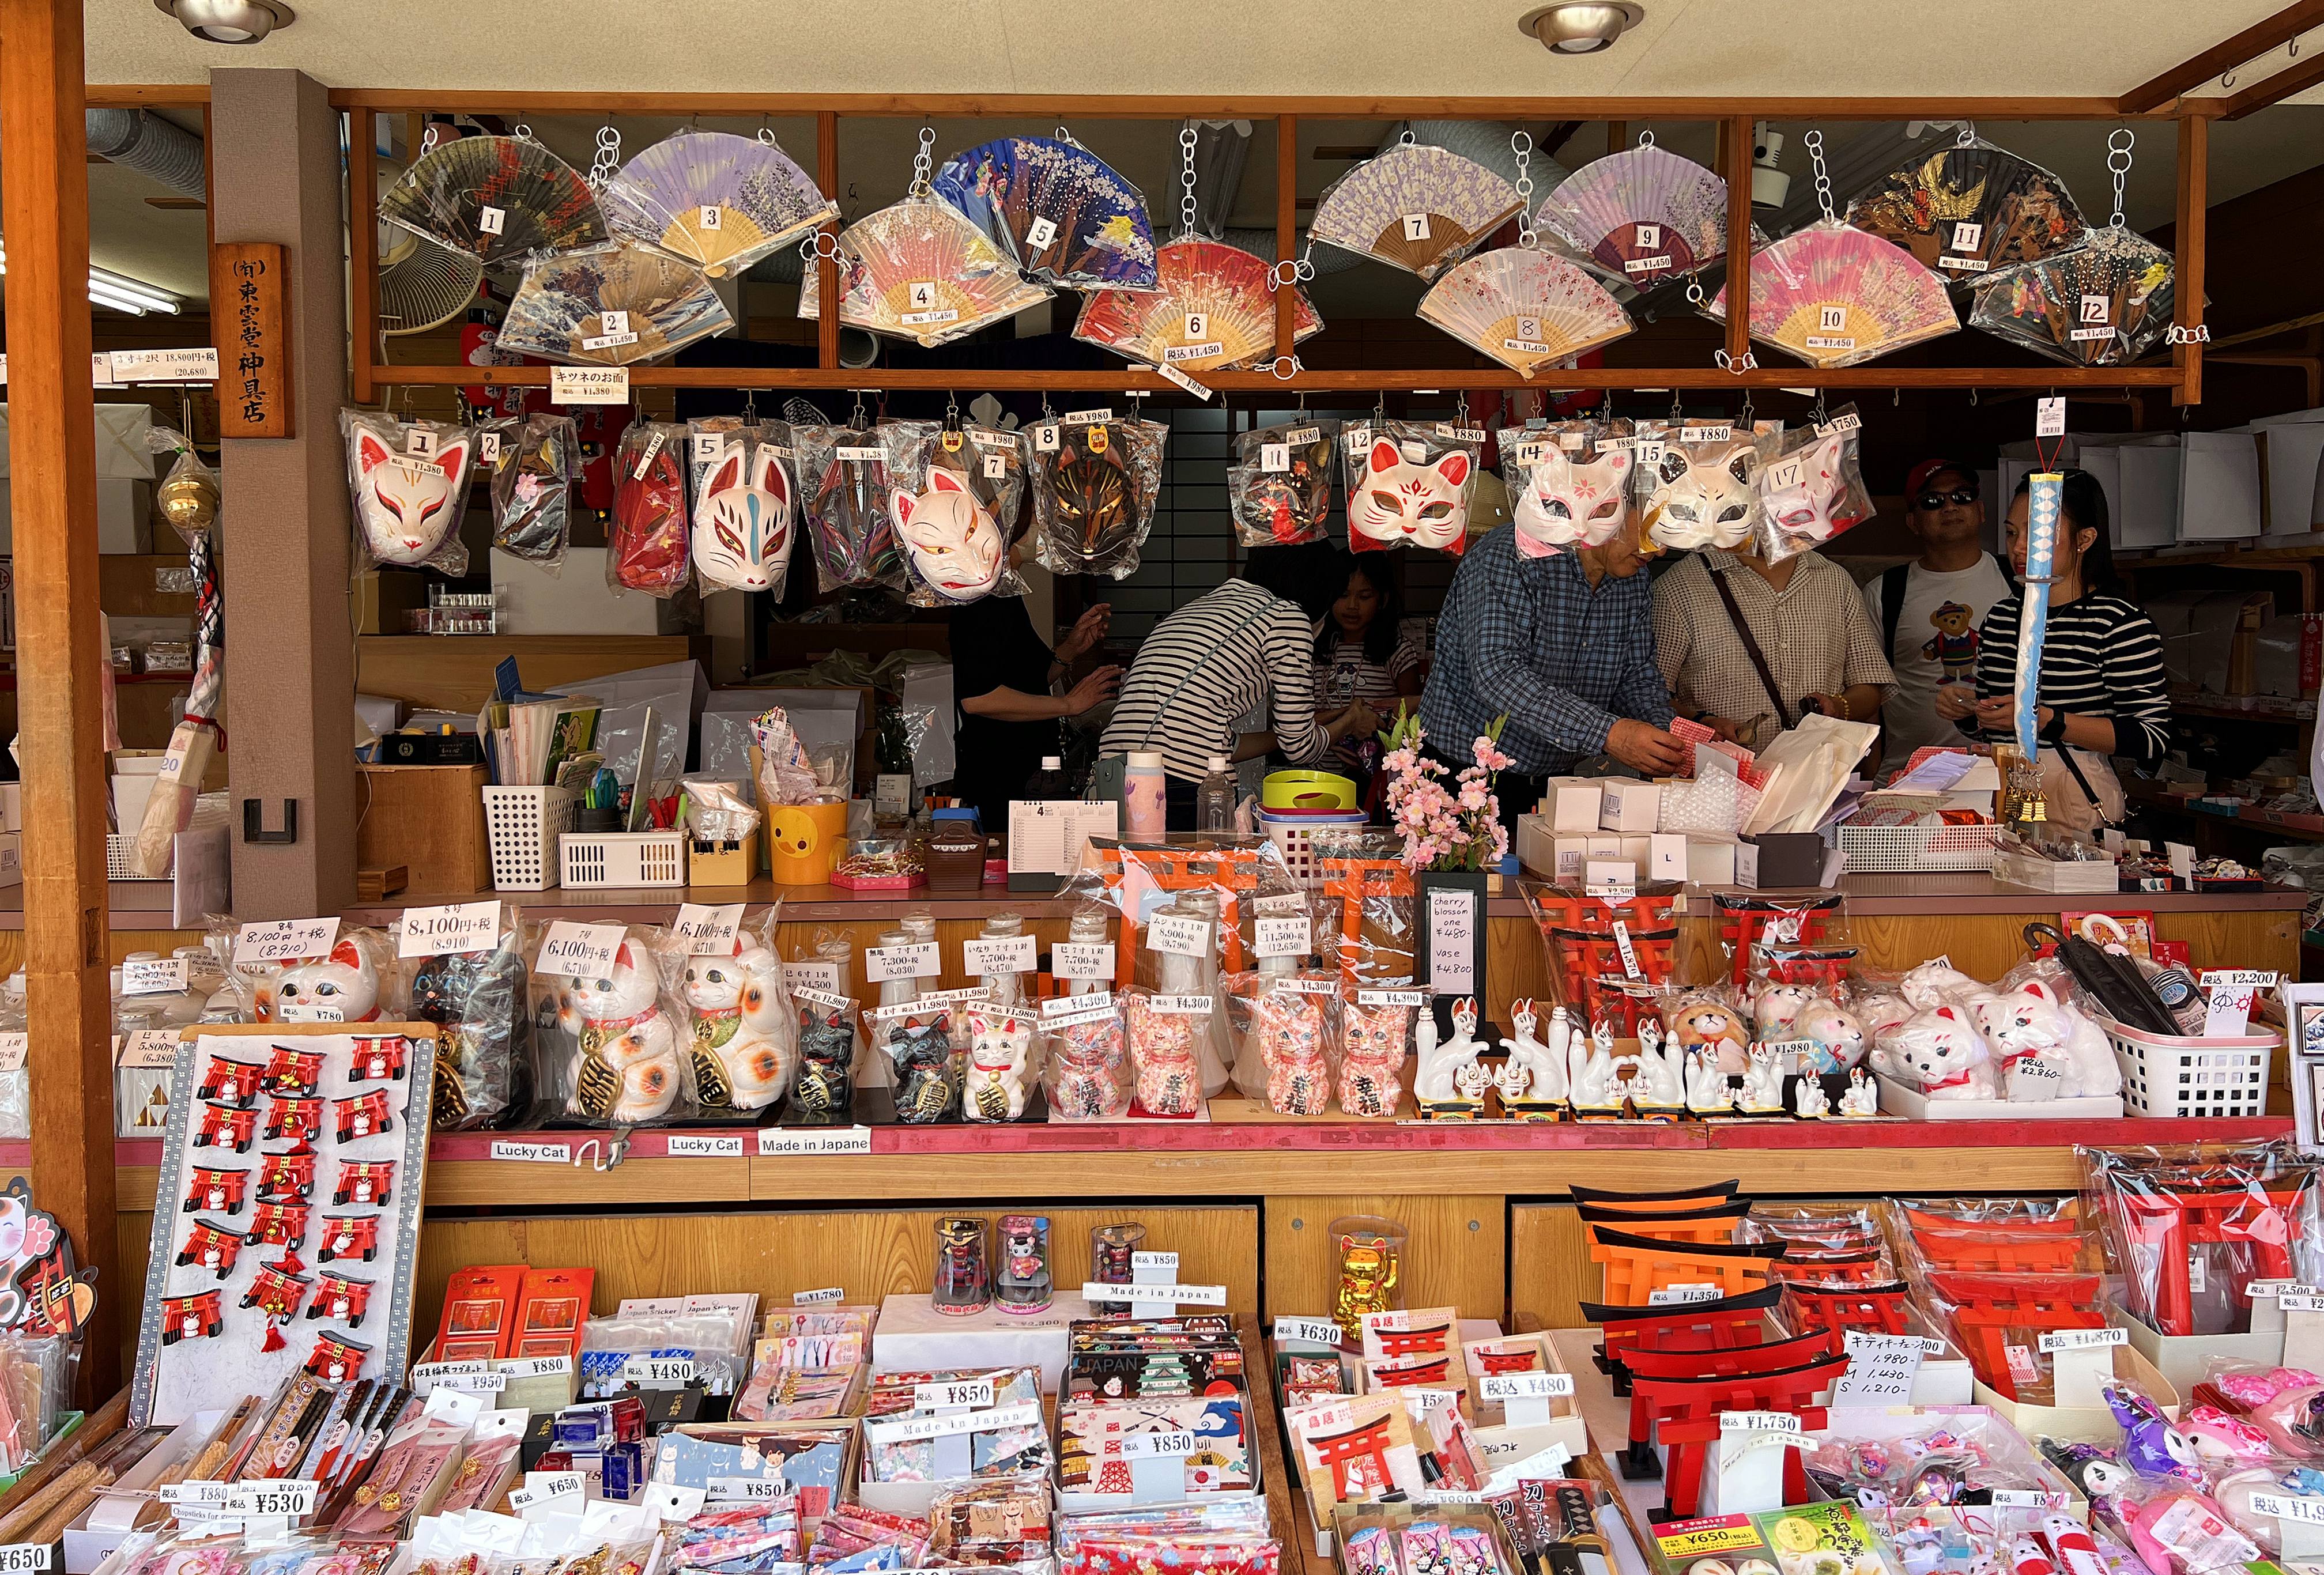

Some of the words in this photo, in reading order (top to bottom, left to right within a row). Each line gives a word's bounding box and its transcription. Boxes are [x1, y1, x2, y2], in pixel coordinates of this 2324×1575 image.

[487, 213, 495, 229] 1
[707, 209, 717, 225] 3
[1036, 225, 1048, 241] 5
[1411, 220, 1421, 236] 7
[1643, 230, 1653, 244] 9
[1957, 229, 1975, 245] 11
[1643, 257, 1670, 269] ¥1,450
[1959, 260, 1986, 270] ¥1,450
[916, 289, 927, 304] 4
[929, 311, 953, 321] ¥1,450
[2081, 302, 2104, 320] 12
[607, 315, 617, 331] 2
[1190, 317, 1201, 333] 6
[1823, 311, 1840, 327] 10
[1522, 320, 1534, 336] 8
[2087, 327, 2114, 338] ¥1,450
[232, 259, 267, 424] (有)東雲堂神具店
[1523, 342, 1547, 353] ¥1,450
[1823, 338, 1851, 348] ¥1,450
[1167, 349, 1186, 360] 税込
[1189, 345, 1220, 357] ¥1,450
[175, 367, 207, 377] (20,680)
[556, 372, 624, 384] キツネのお面
[583, 387, 610, 396] ¥1,380
[1186, 377, 1208, 396] ¥980
[1086, 411, 1108, 421] ¥980
[1831, 415, 1859, 432] ¥750
[993, 433, 1013, 445] ¥980
[1043, 429, 1054, 444] 8
[1299, 430, 1318, 443] ¥880
[1350, 432, 1368, 448] 12
[1454, 429, 1482, 441] ¥880
[1700, 427, 1729, 440] ¥880
[413, 436, 429, 453] 1
[485, 436, 497, 455] 2
[644, 435, 663, 462] ¥1,380
[700, 439, 718, 455] 5
[1617, 438, 1635, 448] ¥880
[861, 450, 886, 459] ¥1,380
[1521, 446, 1544, 460] 14
[1640, 445, 1659, 461] 15
[414, 461, 442, 475] ¥1,380
[990, 459, 999, 474] 7
[1775, 463, 1798, 487] 17
[161, 757, 179, 772] 20
[1037, 806, 1044, 817] 4
[1665, 853, 1672, 862] L
[1608, 887, 1635, 896] ¥2,500
[1434, 896, 1466, 908] cherry
[710, 911, 719, 920] 7号
[408, 916, 491, 936] 8,100円+税
[680, 921, 731, 938] 6,100円+税
[579, 930, 591, 938] 7号
[432, 937, 470, 951] (8,910)
[548, 938, 609, 961] 6,100円+税
[968, 945, 990, 954] いなり
[1162, 938, 1190, 951] (9,790)
[1268, 941, 1301, 952] (12,650)
[979, 953, 1017, 964] 7,700+税
[1436, 949, 1461, 957] vase
[1621, 943, 1638, 976] ¥1,870
[881, 955, 919, 966] 7,300+税
[984, 962, 1013, 973] (8,470)
[561, 961, 590, 975] (6,710)
[885, 965, 916, 976] (8,030)
[1067, 964, 1096, 976] (8,470)
[2202, 975, 2222, 985] 税込
[2232, 972, 2273, 984] ¥2,200
[959, 987, 989, 999] ¥1,980
[1301, 981, 1331, 992] ¥4,300
[822, 993, 847, 1007] ¥1,980
[916, 998, 948, 1011] ¥1,980
[1071, 995, 1107, 1009] ¥4,300
[1176, 997, 1210, 1009] ¥4,300
[1386, 992, 1419, 1003] ¥4,300
[316, 1010, 341, 1022] ¥780
[1006, 1006, 1036, 1019] ¥1,980
[1774, 1041, 1810, 1055] ¥1,980
[1355, 1075, 1381, 1115] 幸福
[496, 1145, 537, 1159] Lucky
[539, 1145, 565, 1158] Cat
[671, 1139, 712, 1152] Lucky
[714, 1139, 740, 1151] Cat
[763, 1140, 801, 1151] Made
[804, 1139, 817, 1150] in
[821, 1139, 867, 1151] Japane
[1153, 1255, 1176, 1265] ¥850
[808, 1289, 842, 1303] ¥1,780
[1110, 1286, 1143, 1297] Made
[1150, 1287, 1163, 1297] in
[1171, 1289, 1210, 1300] Japan
[1681, 1290, 1719, 1301] ¥1,350
[2251, 1286, 2265, 1294] 税込
[2284, 1297, 2299, 1306] 税込
[624, 1308, 648, 1317] Japan
[650, 1308, 677, 1316] Sticker
[687, 1305, 711, 1313] Japan
[1370, 1316, 1393, 1328] 鳥居
[1278, 1325, 1292, 1335] 税込
[1299, 1324, 1338, 1344] ¥630
[2043, 1336, 2066, 1348] 税込
[2074, 1330, 2122, 1344] ¥1,870
[533, 1358, 563, 1373] ¥880
[650, 1364, 691, 1379] ¥480
[1081, 1357, 1138, 1373] JAPAN
[1845, 1368, 1856, 1379] M
[472, 1375, 503, 1389] ¥950
[1485, 1377, 1518, 1396] 税込
[1529, 1378, 1566, 1393] ¥480
[1840, 1382, 1851, 1393] S
[916, 1392, 932, 1402] 税込
[947, 1385, 990, 1404] ¥850
[903, 1422, 941, 1435] Made
[950, 1417, 966, 1429] in
[974, 1411, 1020, 1427] Japan
[1308, 1412, 1334, 1429] 鳥居
[1721, 1417, 1739, 1427] 税込
[1746, 1415, 1797, 1432] ¥1,750
[1152, 1434, 1191, 1453] ¥850
[1362, 1456, 1381, 1486] 厄除
[162, 1489, 178, 1499] 税込
[200, 1487, 228, 1501] ¥880
[514, 1493, 533, 1505] 税込
[548, 1478, 579, 1495] ¥650
[710, 1485, 727, 1494] 税込
[746, 1483, 782, 1496] ¥850
[229, 1498, 246, 1509] 税込
[255, 1493, 305, 1514] ¥530
[1995, 1494, 2012, 1503] 税込
[173, 1506, 206, 1520] Chopsticks
[1523, 1482, 1550, 1538] 刀コーム
[2254, 1498, 2280, 1514] 税込
[1496, 1498, 1528, 1552] 刀コーム
[1685, 1531, 1729, 1545] ¥650
[0, 1548, 44, 1571] ¥650
